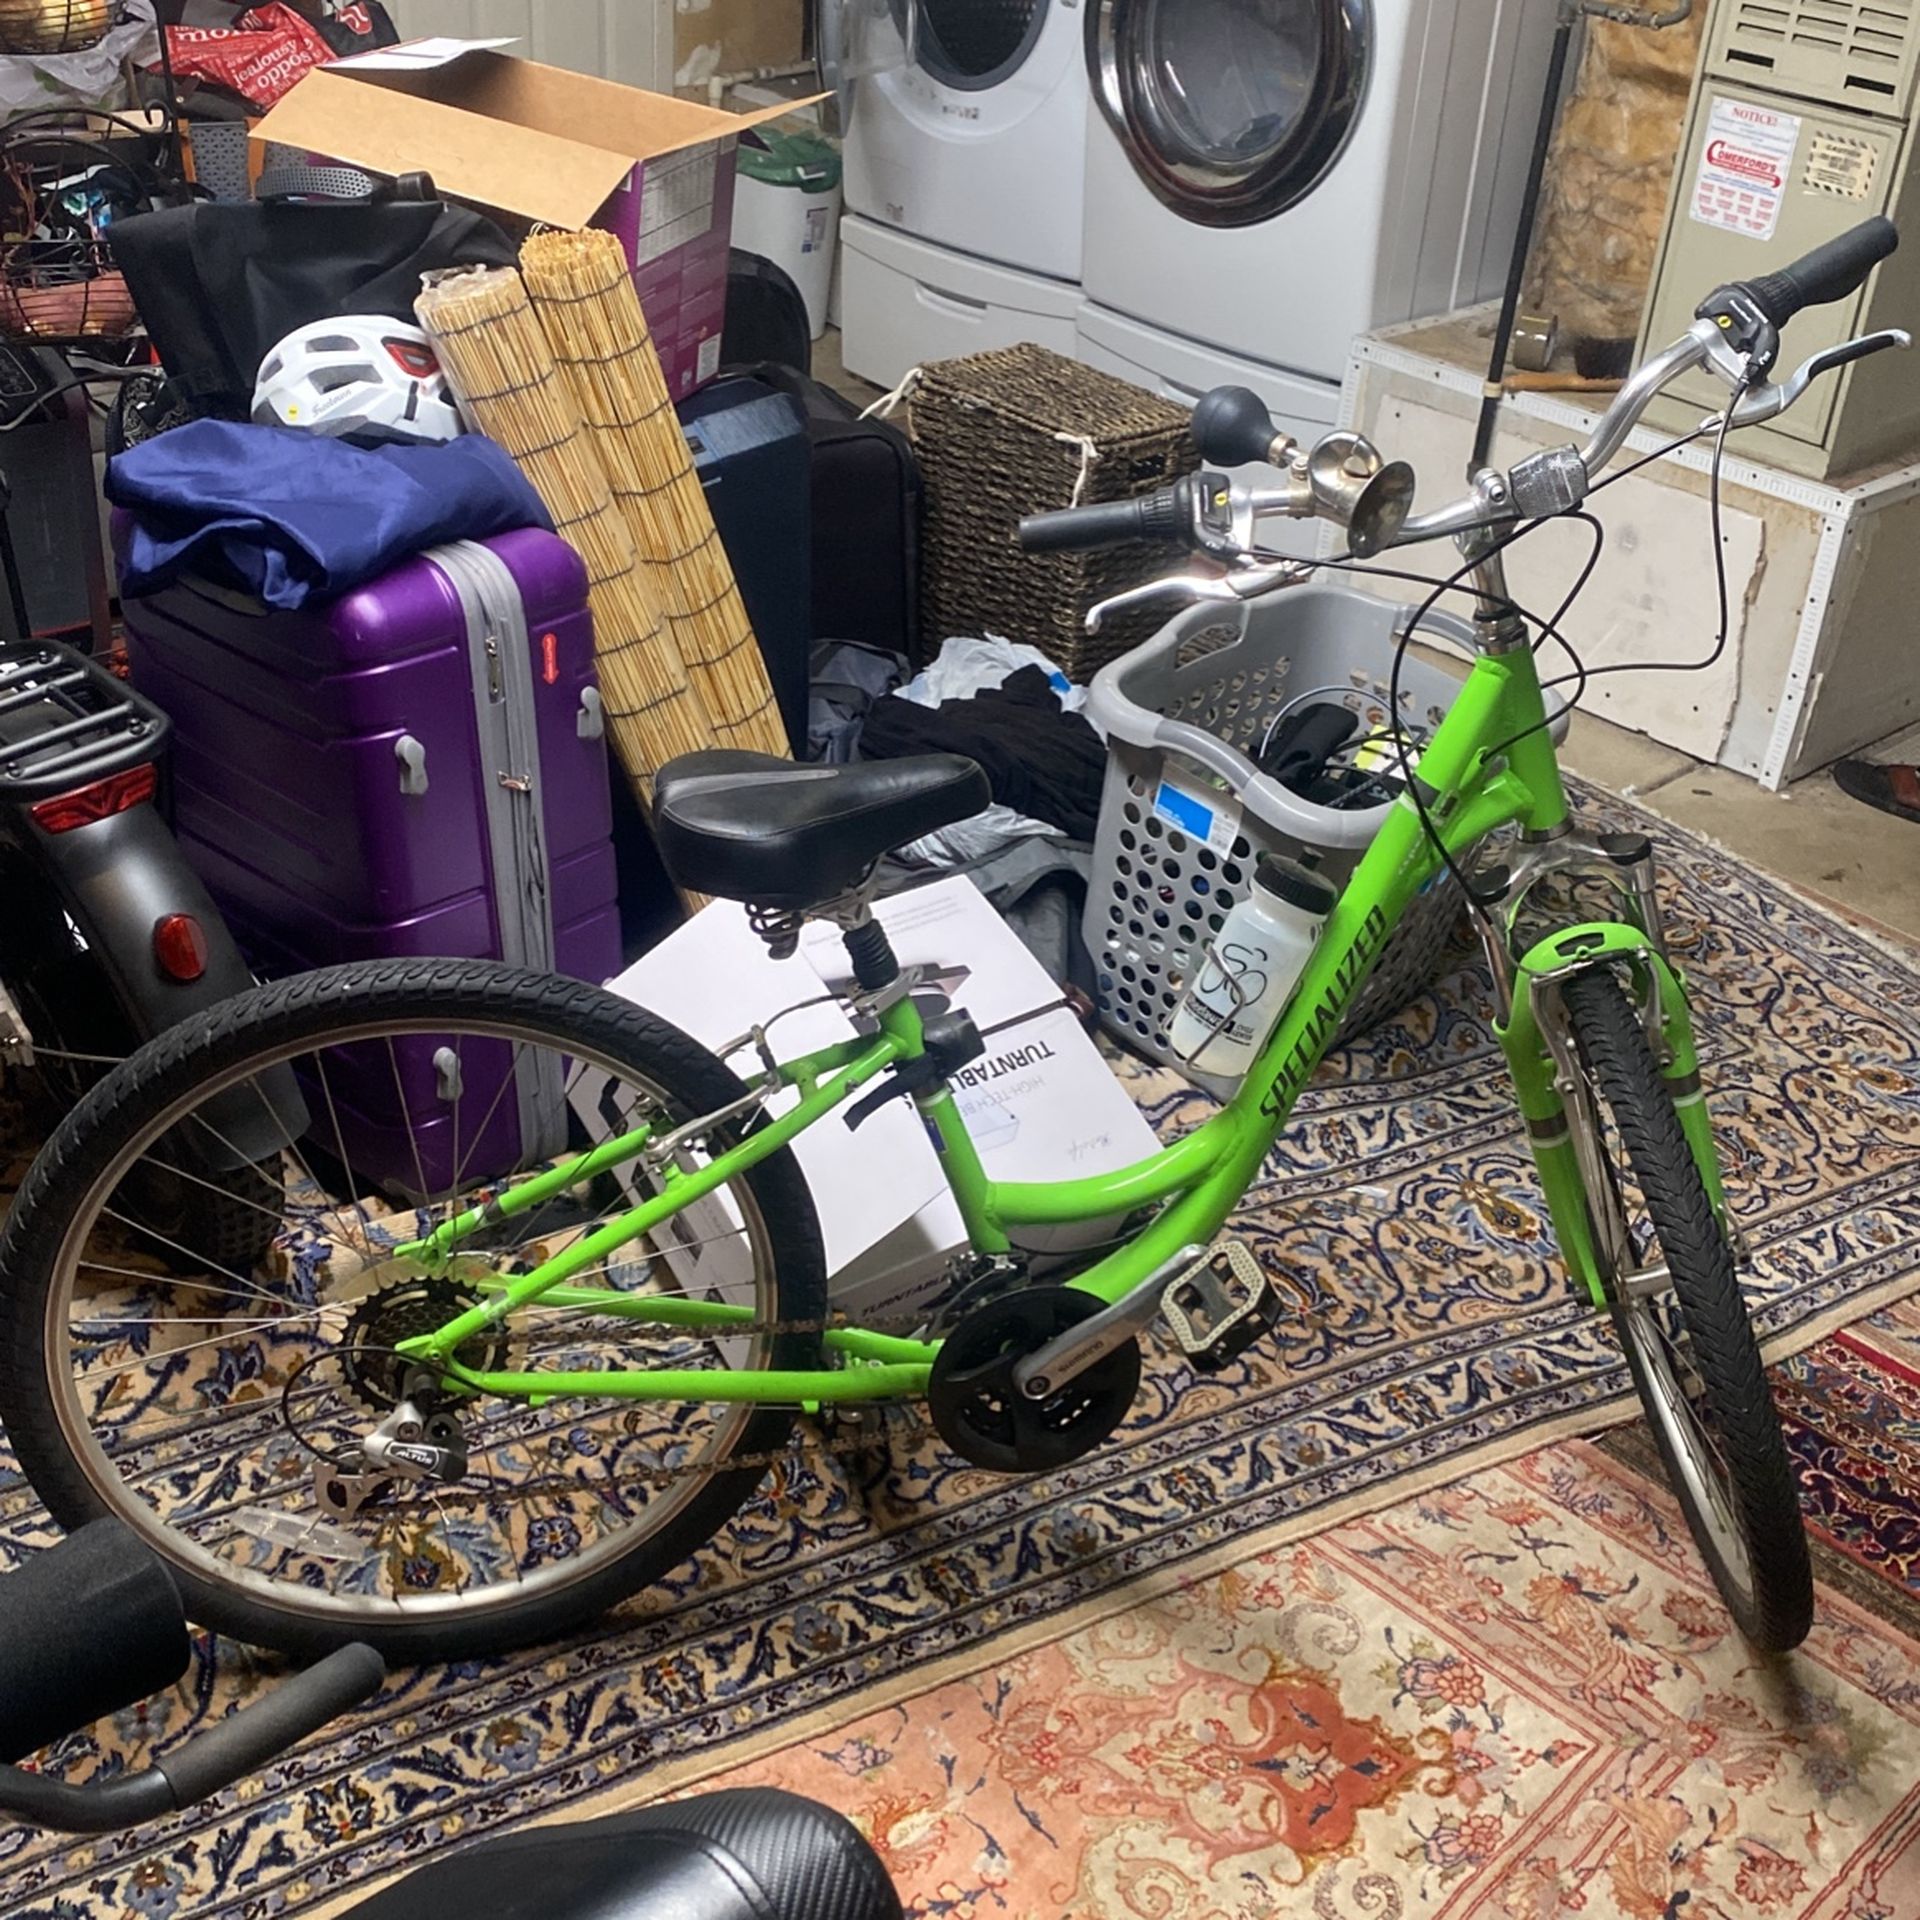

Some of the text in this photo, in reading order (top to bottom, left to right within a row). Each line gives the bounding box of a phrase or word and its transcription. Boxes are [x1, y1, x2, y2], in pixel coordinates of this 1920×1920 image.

[237, 39, 297, 89] jealousy
[1707, 140, 1778, 173] COMERFORD'S
[1259, 904, 1387, 1118] SPECIALIZED
[977, 1075, 1047, 1113] HIGH-TECH
